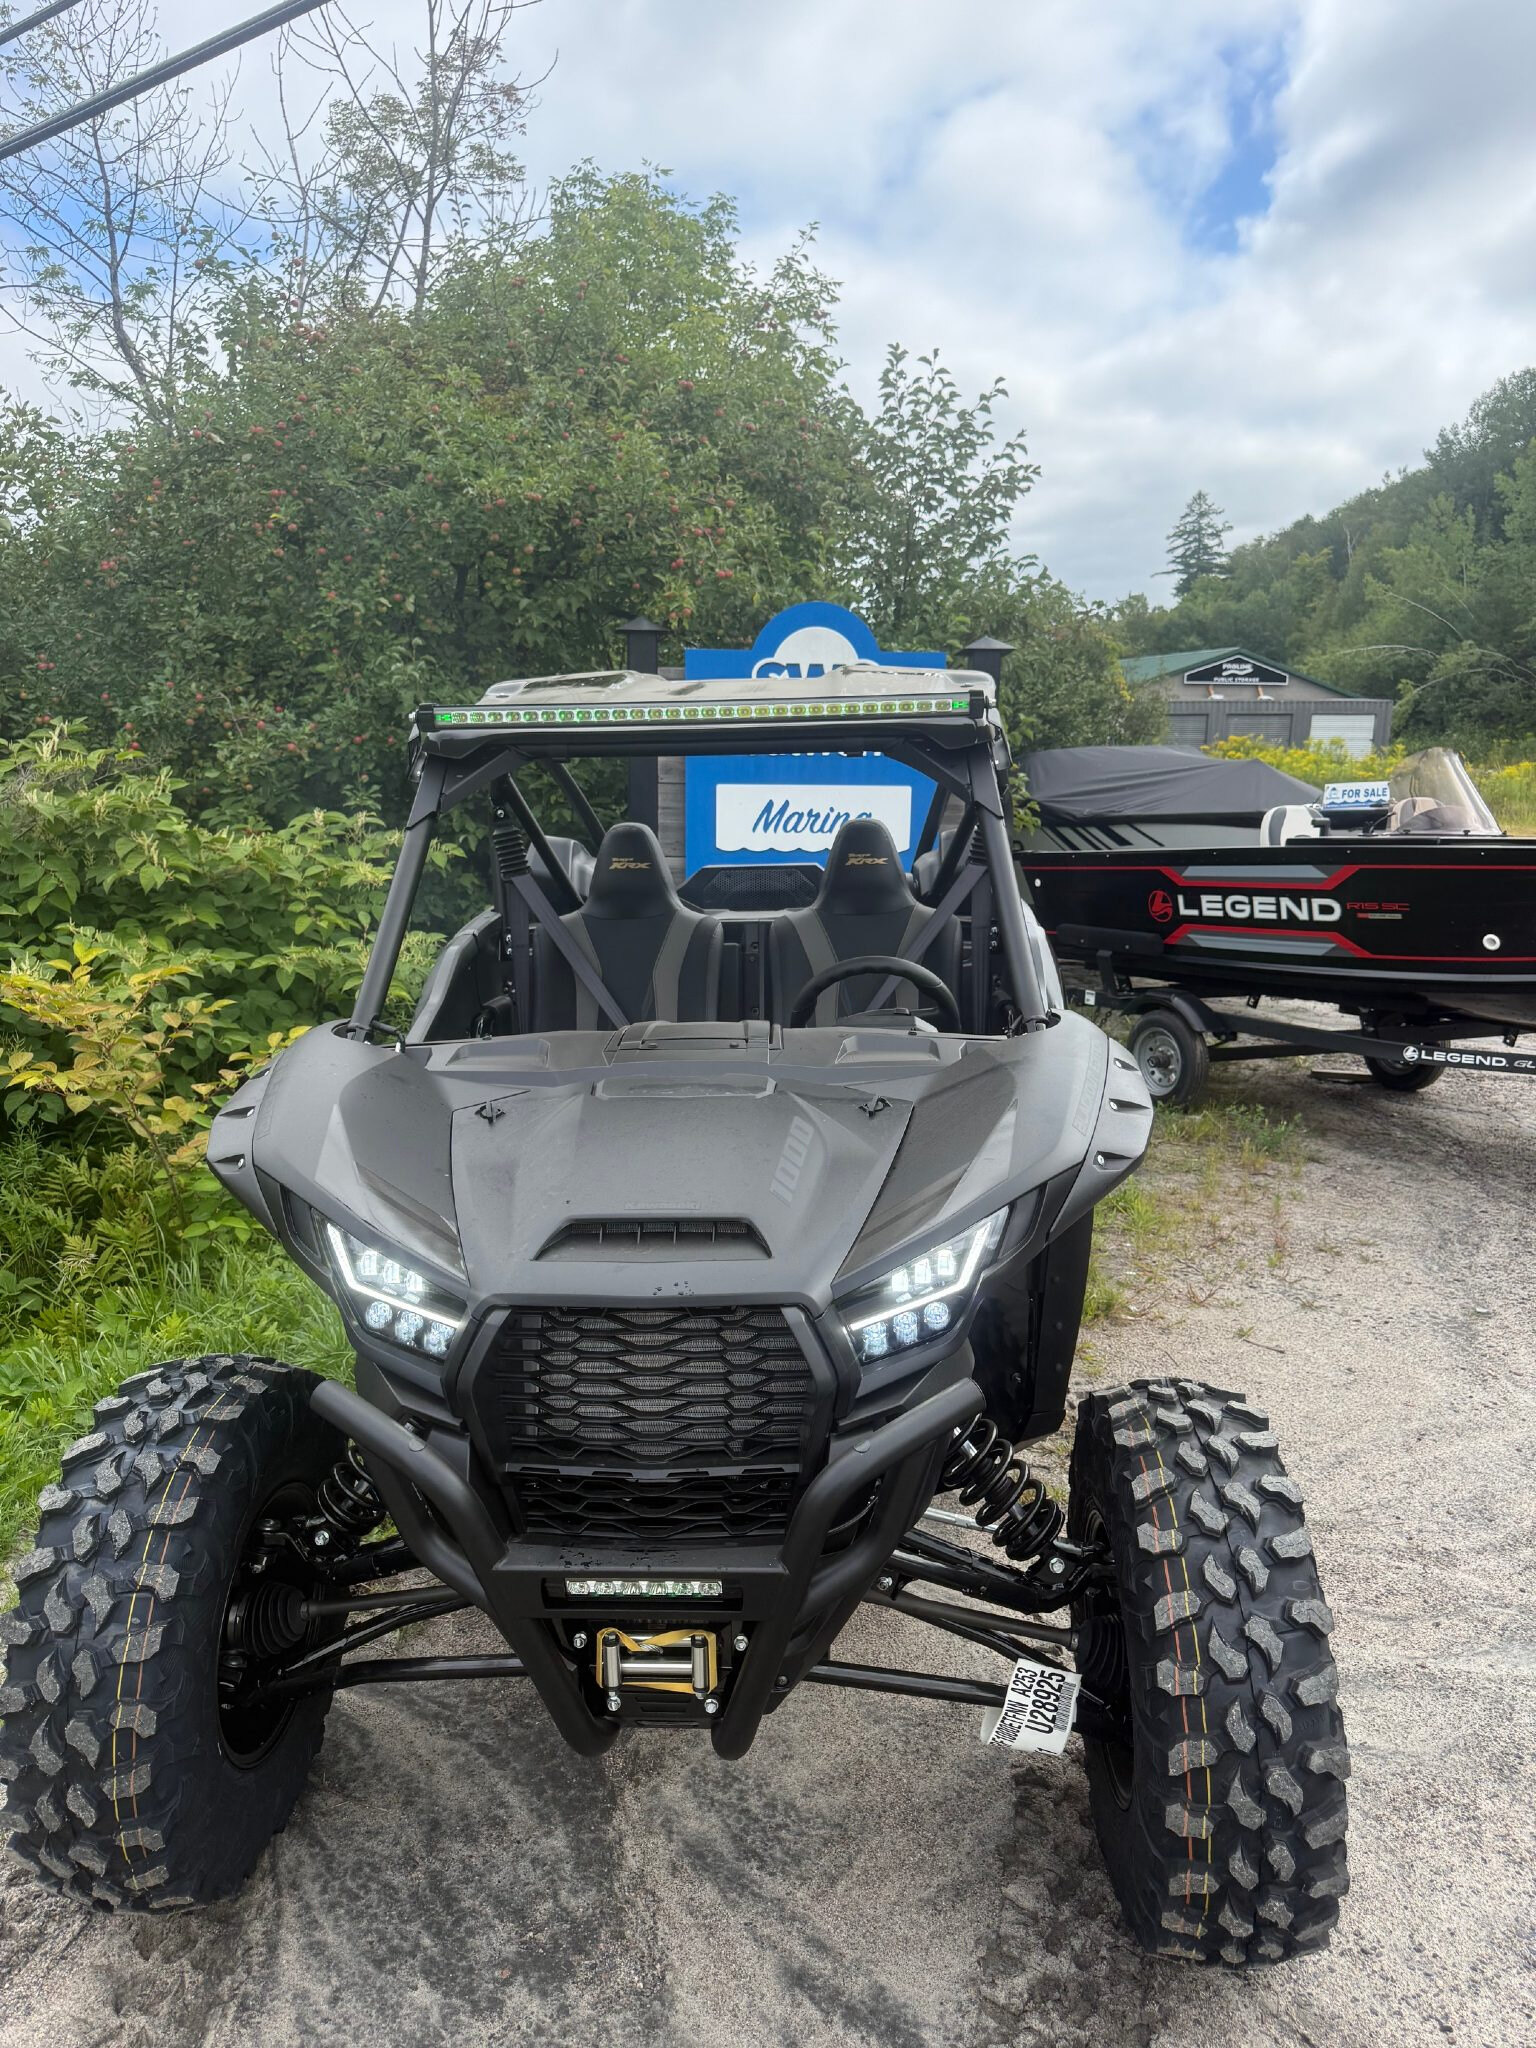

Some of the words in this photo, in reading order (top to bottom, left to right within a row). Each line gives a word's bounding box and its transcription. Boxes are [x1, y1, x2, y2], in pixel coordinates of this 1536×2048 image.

[1341, 789, 1361, 799] FOR
[1363, 787, 1388, 798] SALE
[1177, 894, 1342, 922] LEGEND
[1011, 1667, 1037, 1698] A253
[1025, 1670, 1066, 1734] U28925
